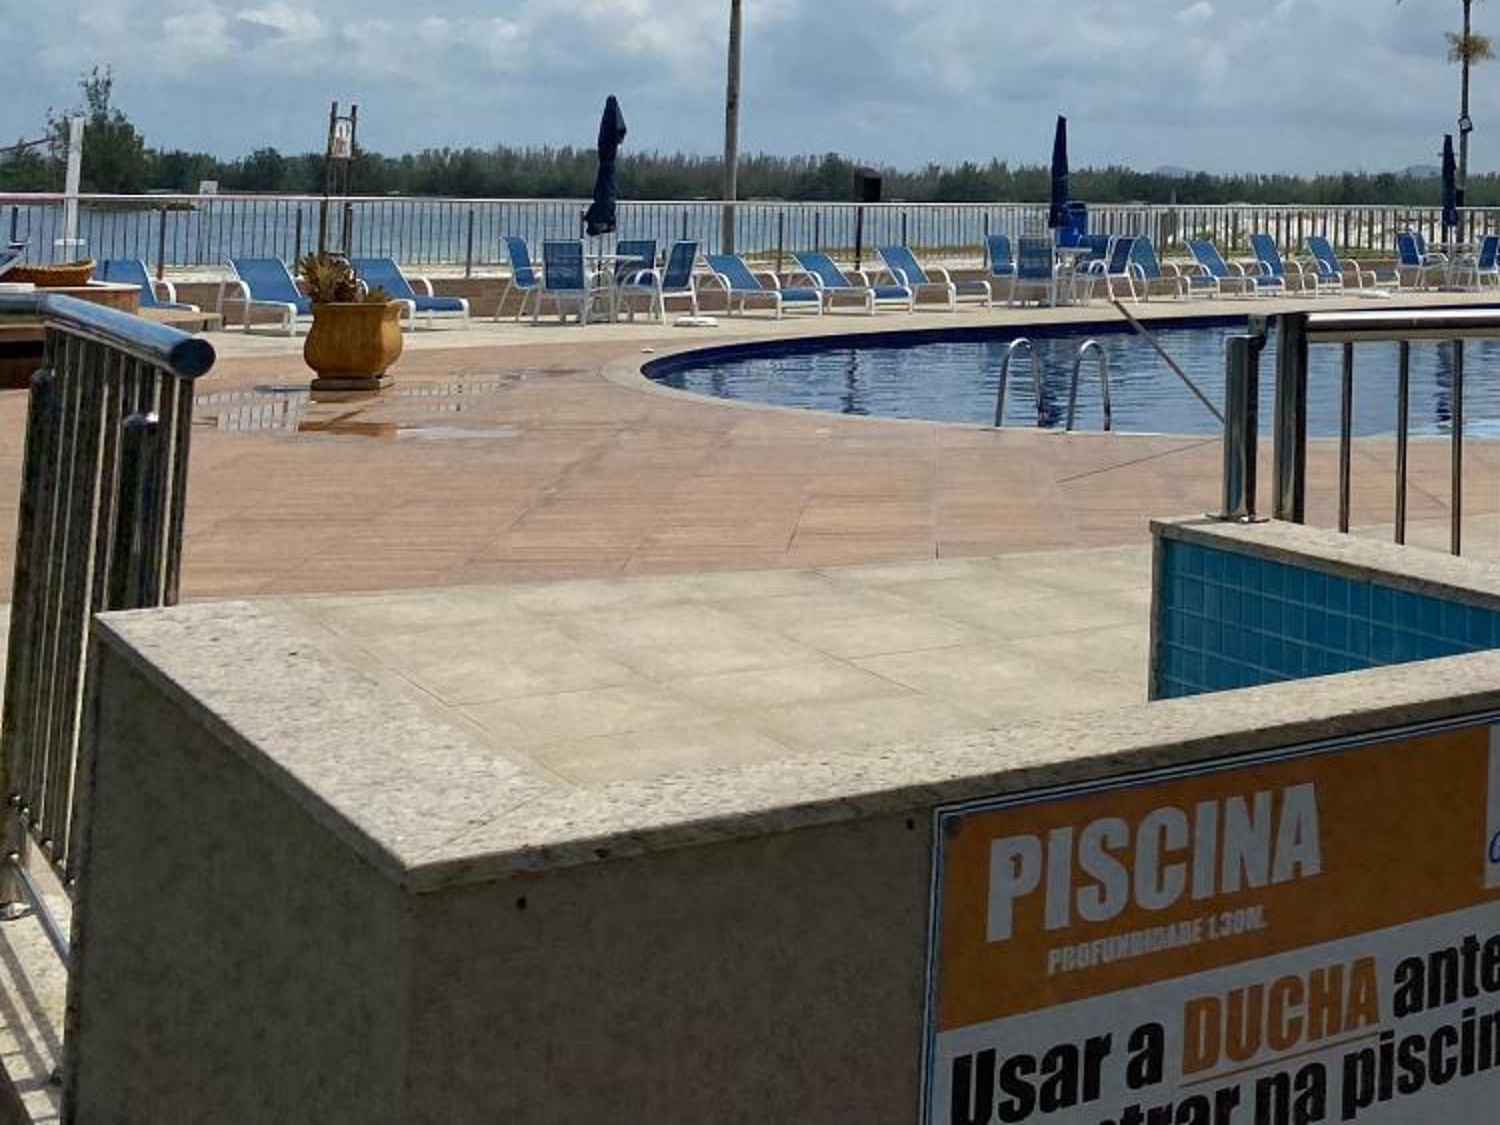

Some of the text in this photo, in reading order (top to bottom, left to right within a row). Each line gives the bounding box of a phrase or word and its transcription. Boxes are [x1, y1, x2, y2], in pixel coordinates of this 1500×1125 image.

[986, 783, 1321, 942] PISCINA
[951, 1033, 1112, 1125] Usar
[1126, 1022, 1164, 1090] a
[1182, 955, 1379, 1075] DUCHA
[1254, 1062, 1326, 1125] na
